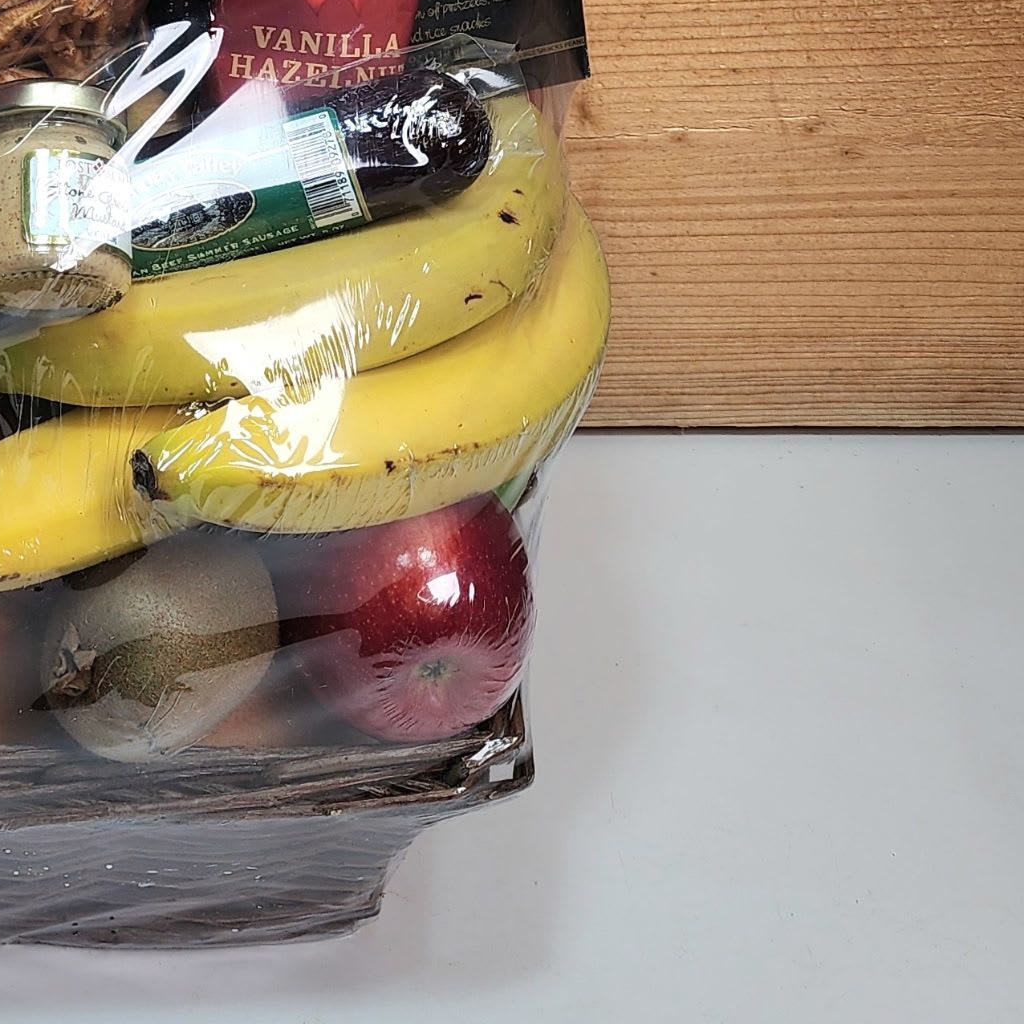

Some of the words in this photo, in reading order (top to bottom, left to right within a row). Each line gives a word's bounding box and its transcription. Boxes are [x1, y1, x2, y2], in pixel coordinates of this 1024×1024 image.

[252, 25, 401, 58] VANILLA
[228, 53, 405, 90] HAZELN
[151, 257, 184, 272] BEEF
[187, 241, 239, 263] SUMMER
[241, 224, 299, 247] SAUSAGE
